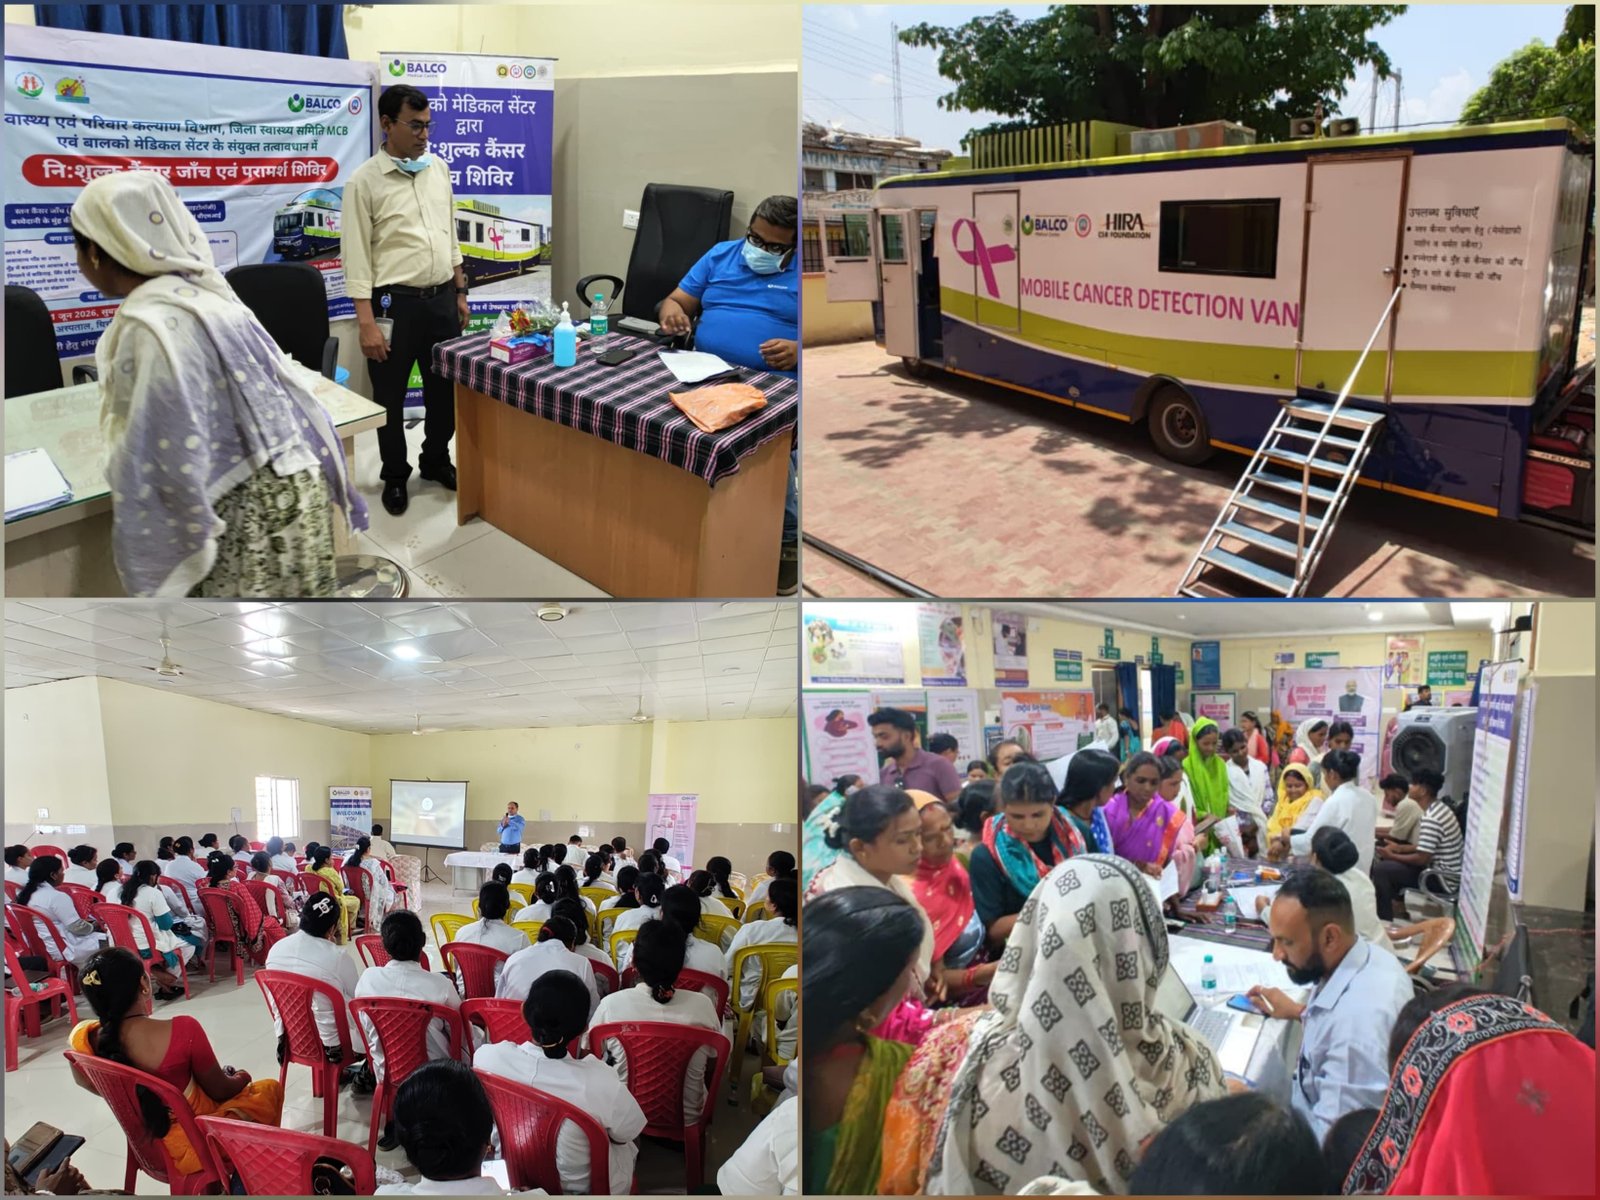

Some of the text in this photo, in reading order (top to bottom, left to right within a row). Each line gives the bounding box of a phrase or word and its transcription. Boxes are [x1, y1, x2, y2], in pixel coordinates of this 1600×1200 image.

[407, 63, 447, 74] BALCO
[306, 97, 342, 110] BALCO
[452, 94, 504, 113] मेडिकल
[508, 95, 536, 115] सेंटर
[4, 113, 349, 136] वास्थ्य एवं परिवार कल्याण विभाग, जिला स्वास्थ्य समिति MCB
[456, 118, 483, 135] द्वारा
[56, 134, 79, 149] एवं
[82, 135, 130, 149] बालको
[134, 136, 181, 151] मेडिकल
[185, 137, 210, 151] सेंटर
[212, 138, 225, 151] के
[227, 139, 260, 154] संयुक्त
[311, 139, 319, 151] में
[485, 137, 526, 159] कैंसर
[42, 158, 123, 184] नि:शुल्
[176, 161, 212, 179] जाँच
[215, 161, 238, 180] एवं
[242, 161, 288, 179] परामर्श
[291, 161, 328, 177] शिविर
[466, 165, 514, 186] शिविर
[1035, 218, 1068, 231] BALCO
[1106, 213, 1145, 231] HIRA
[1020, 277, 1299, 328] MOBILE CANCER DETECTION VAN
